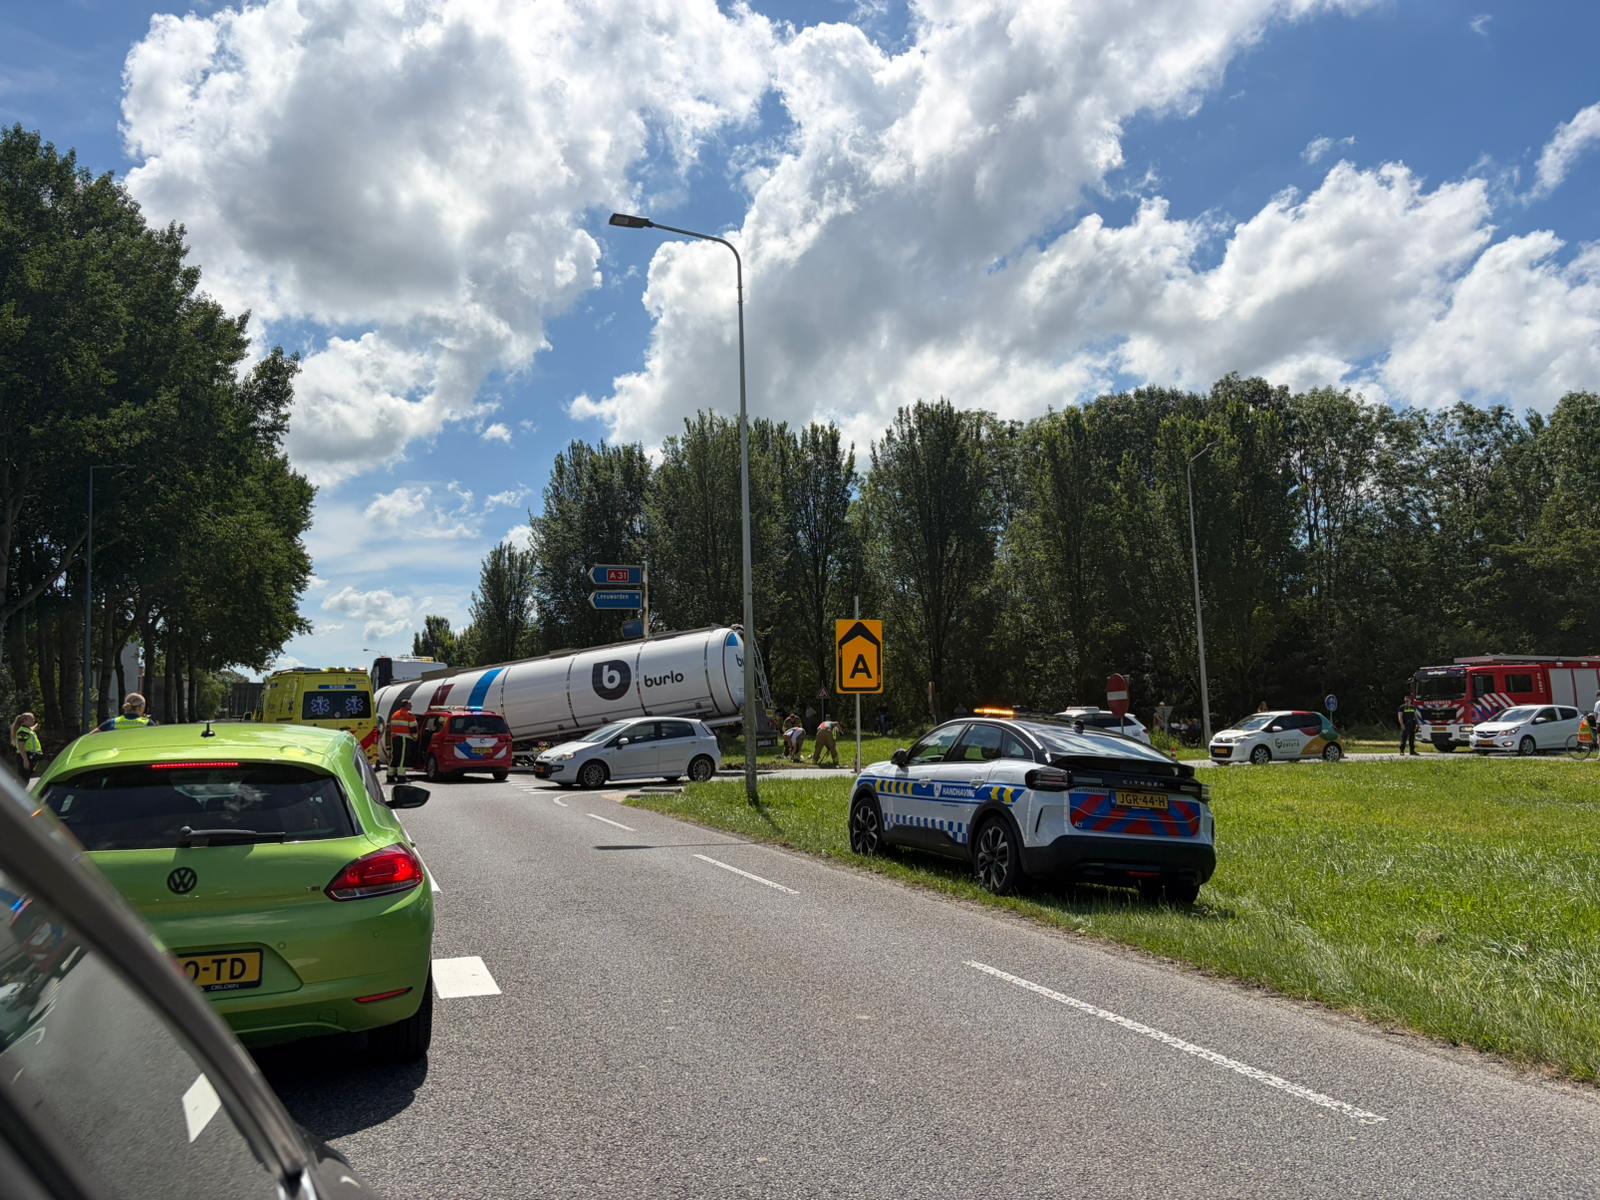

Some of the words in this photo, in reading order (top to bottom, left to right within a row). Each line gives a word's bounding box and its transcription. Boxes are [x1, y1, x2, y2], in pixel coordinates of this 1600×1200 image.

[849, 653, 873, 679] A
[643, 670, 684, 688] burlo
[941, 786, 976, 798] HANDHAVING
[1119, 793, 1167, 807] JGR-44-H
